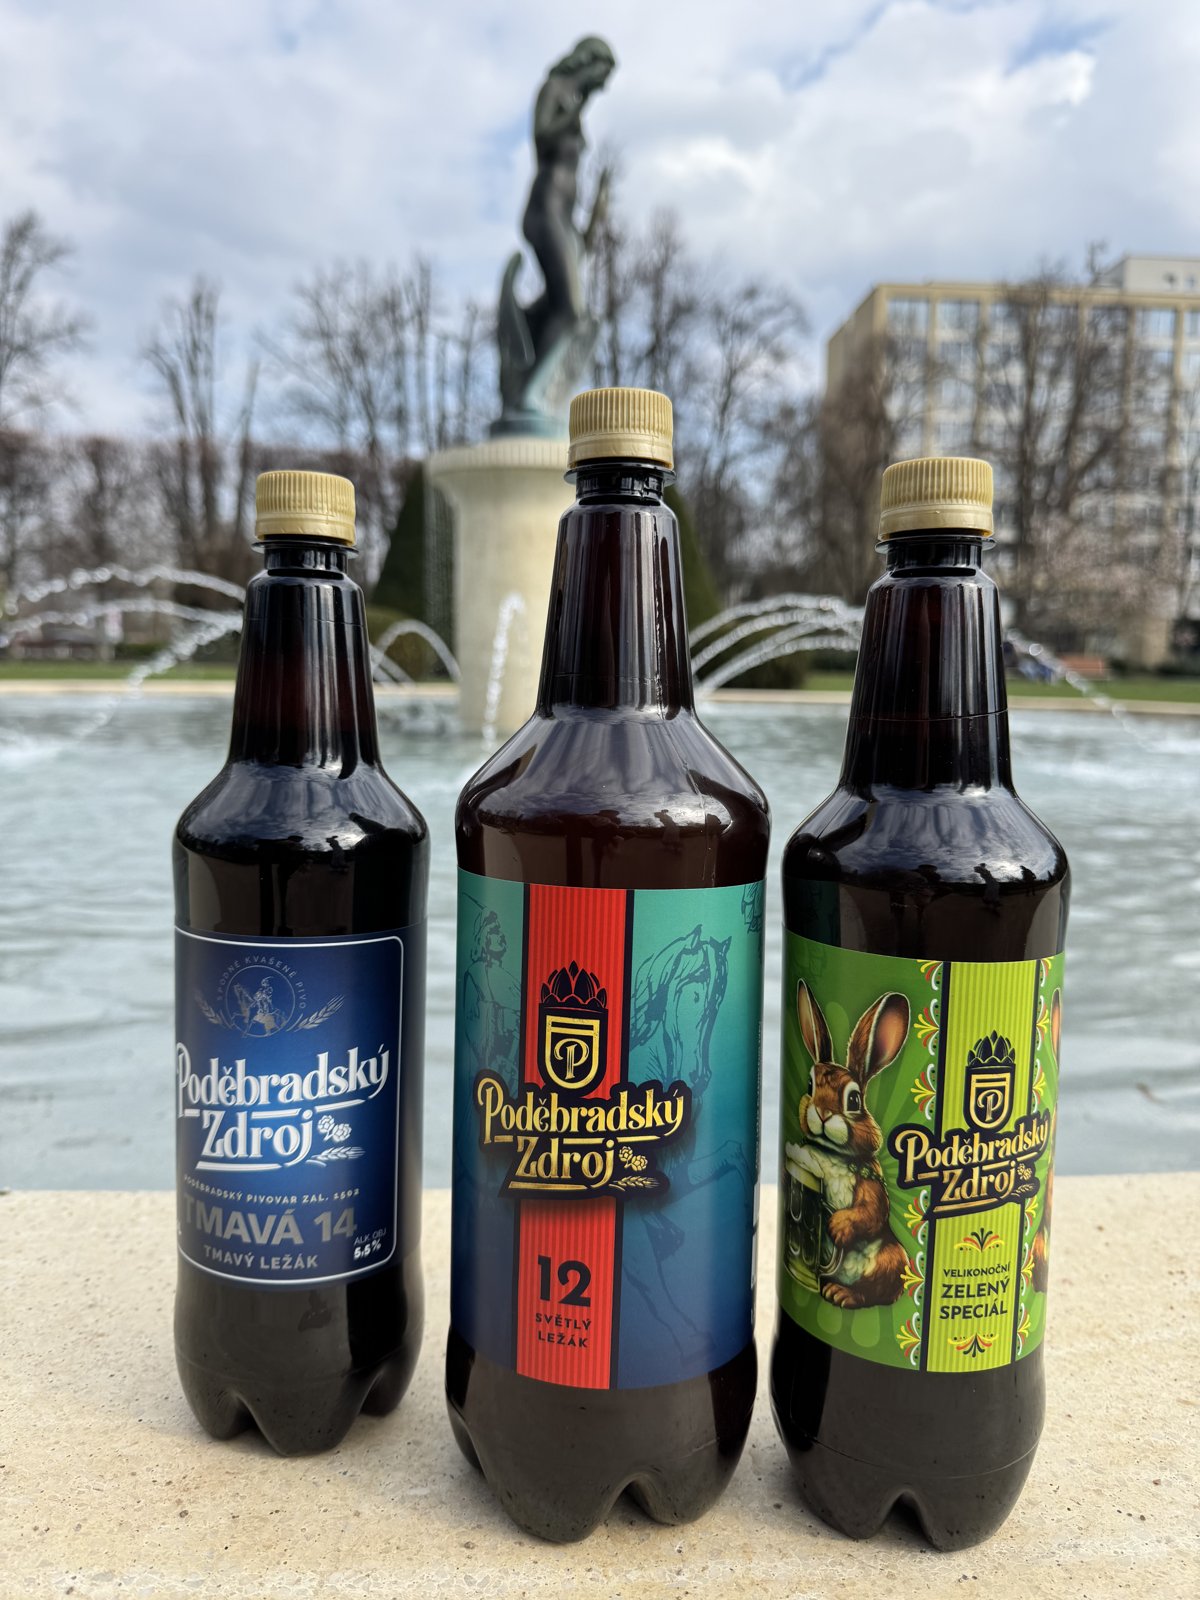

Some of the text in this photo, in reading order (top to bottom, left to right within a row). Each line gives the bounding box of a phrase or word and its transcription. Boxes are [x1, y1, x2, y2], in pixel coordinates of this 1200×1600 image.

[245, 954, 297, 978] KVAŠENÉ
[296, 981, 307, 1009] PIVO
[176, 1042, 390, 1119] Poděbradský
[477, 1077, 684, 1145] Poděbradský
[201, 1109, 313, 1167] Zdroj
[894, 1115, 1049, 1183] Poděbradský
[515, 1136, 615, 1189] Zdroj
[940, 1160, 1016, 1202] Zdroj
[183, 1191, 357, 1245] TMAVÁ 14
[246, 1193, 298, 1205] PIVOVAR
[203, 1244, 318, 1270] TMAVÝ LEŽÁK
[943, 1261, 1011, 1278] VELIKONOČNÍ
[538, 1255, 591, 1307] 12
[941, 1276, 1010, 1299] ZELENÝ
[535, 1312, 592, 1331] SVĚTLÝ
[939, 1298, 1008, 1320] SPECIÁL
[538, 1331, 588, 1348] LEŽÁK
